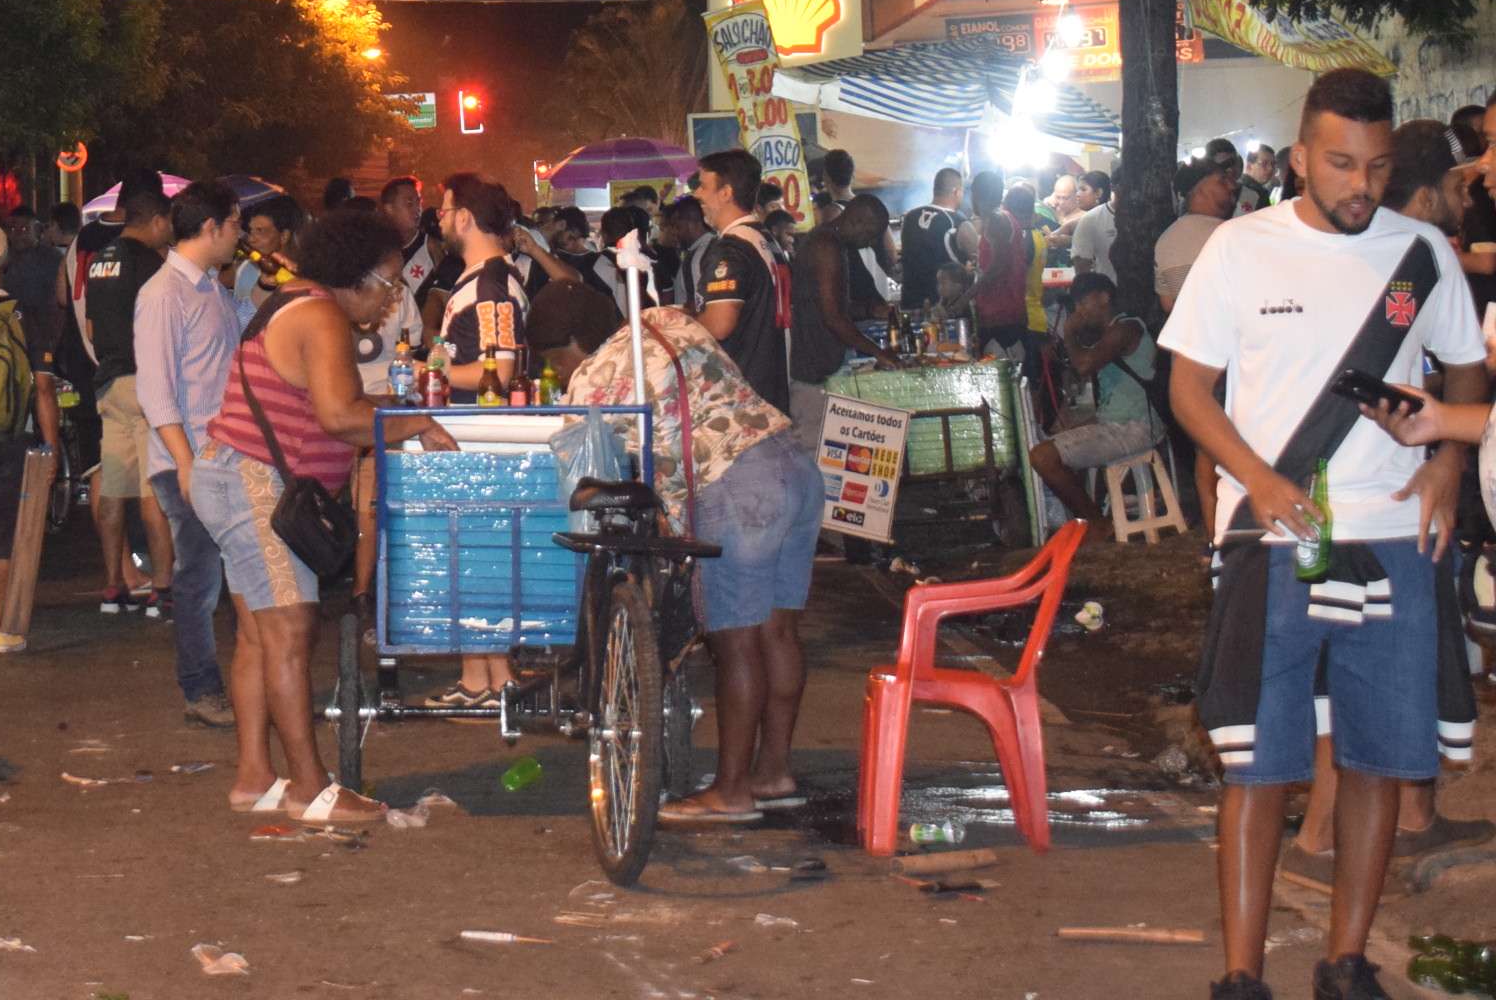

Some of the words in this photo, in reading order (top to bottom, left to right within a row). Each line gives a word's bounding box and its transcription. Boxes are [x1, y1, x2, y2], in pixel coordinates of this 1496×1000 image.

[961, 21, 1000, 35] ETANOL
[88, 261, 121, 278] CAIXA
[829, 404, 875, 422] Aceitamos
[876, 414, 902, 428] todos
[839, 426, 850, 436] os
